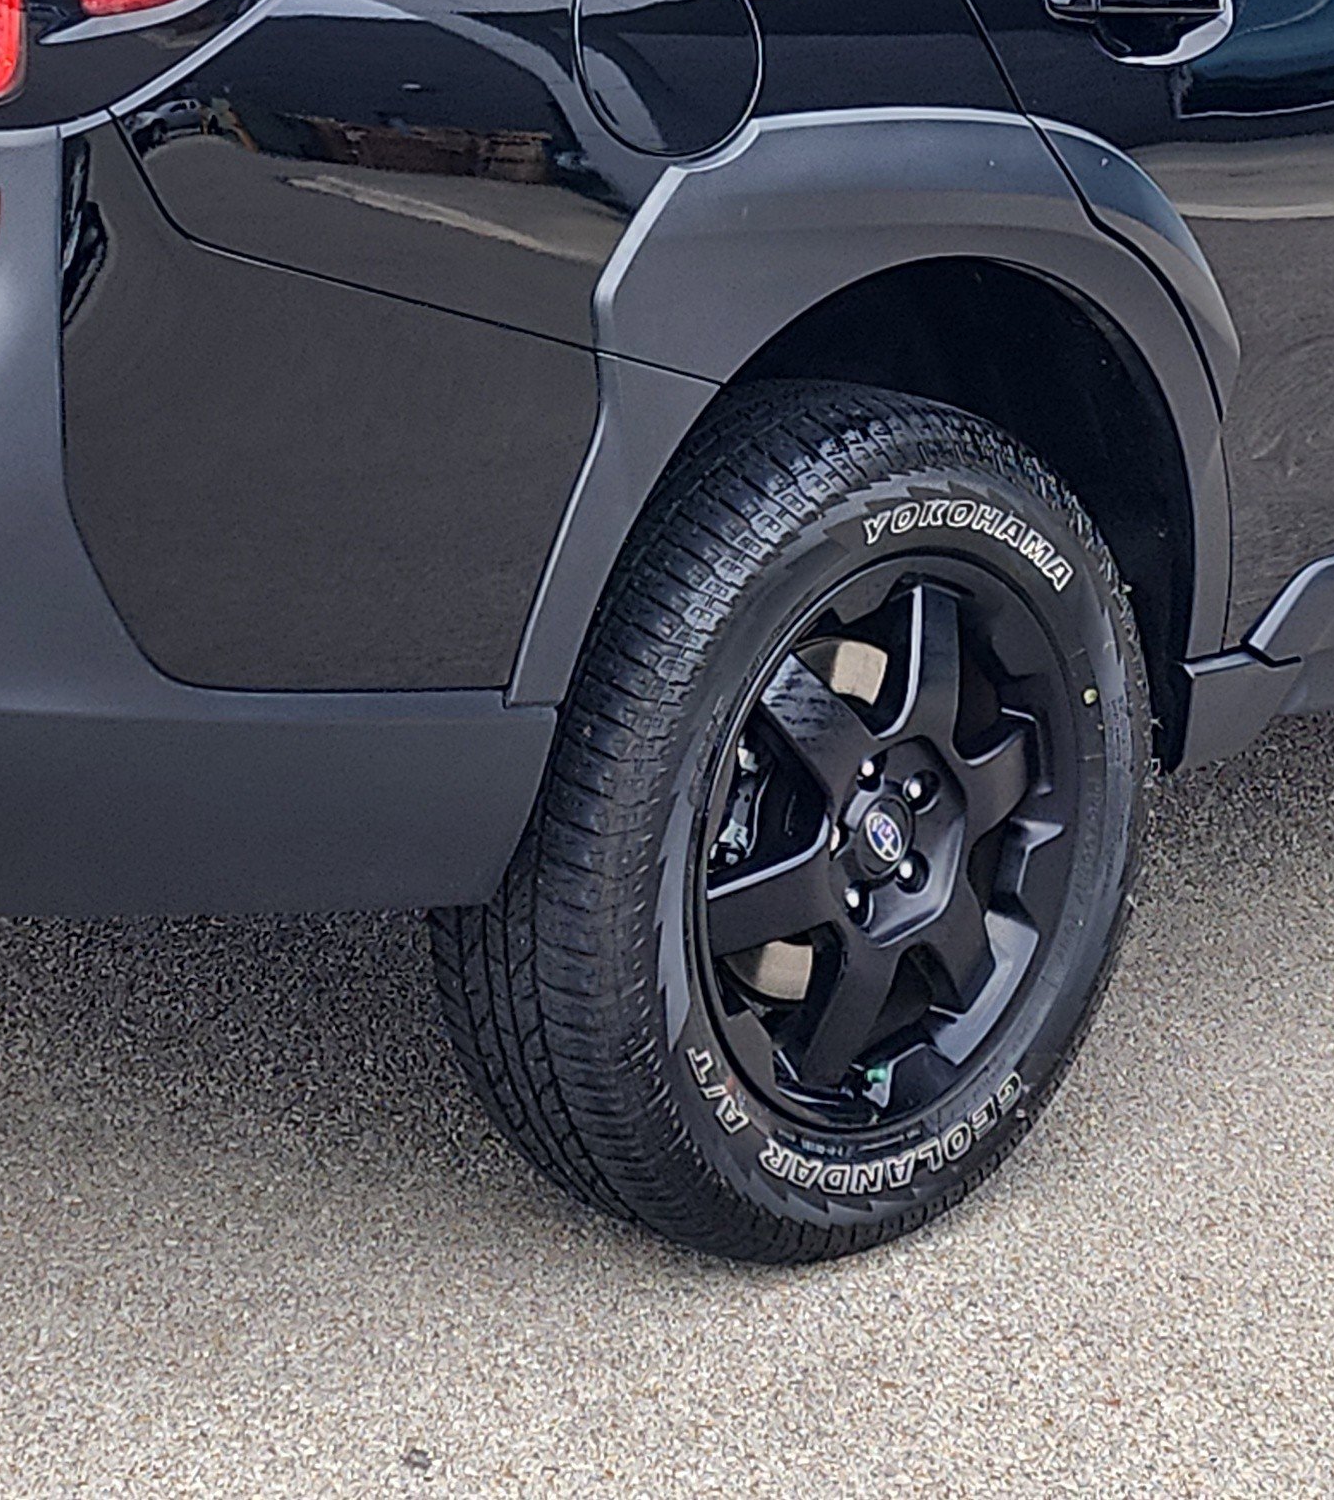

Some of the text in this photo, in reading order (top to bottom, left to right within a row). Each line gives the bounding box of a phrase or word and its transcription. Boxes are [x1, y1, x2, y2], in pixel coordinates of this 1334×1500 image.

[861, 498, 1076, 594] YOKOHAMA
[684, 1046, 1024, 1196] GEOLANDAR A/T
